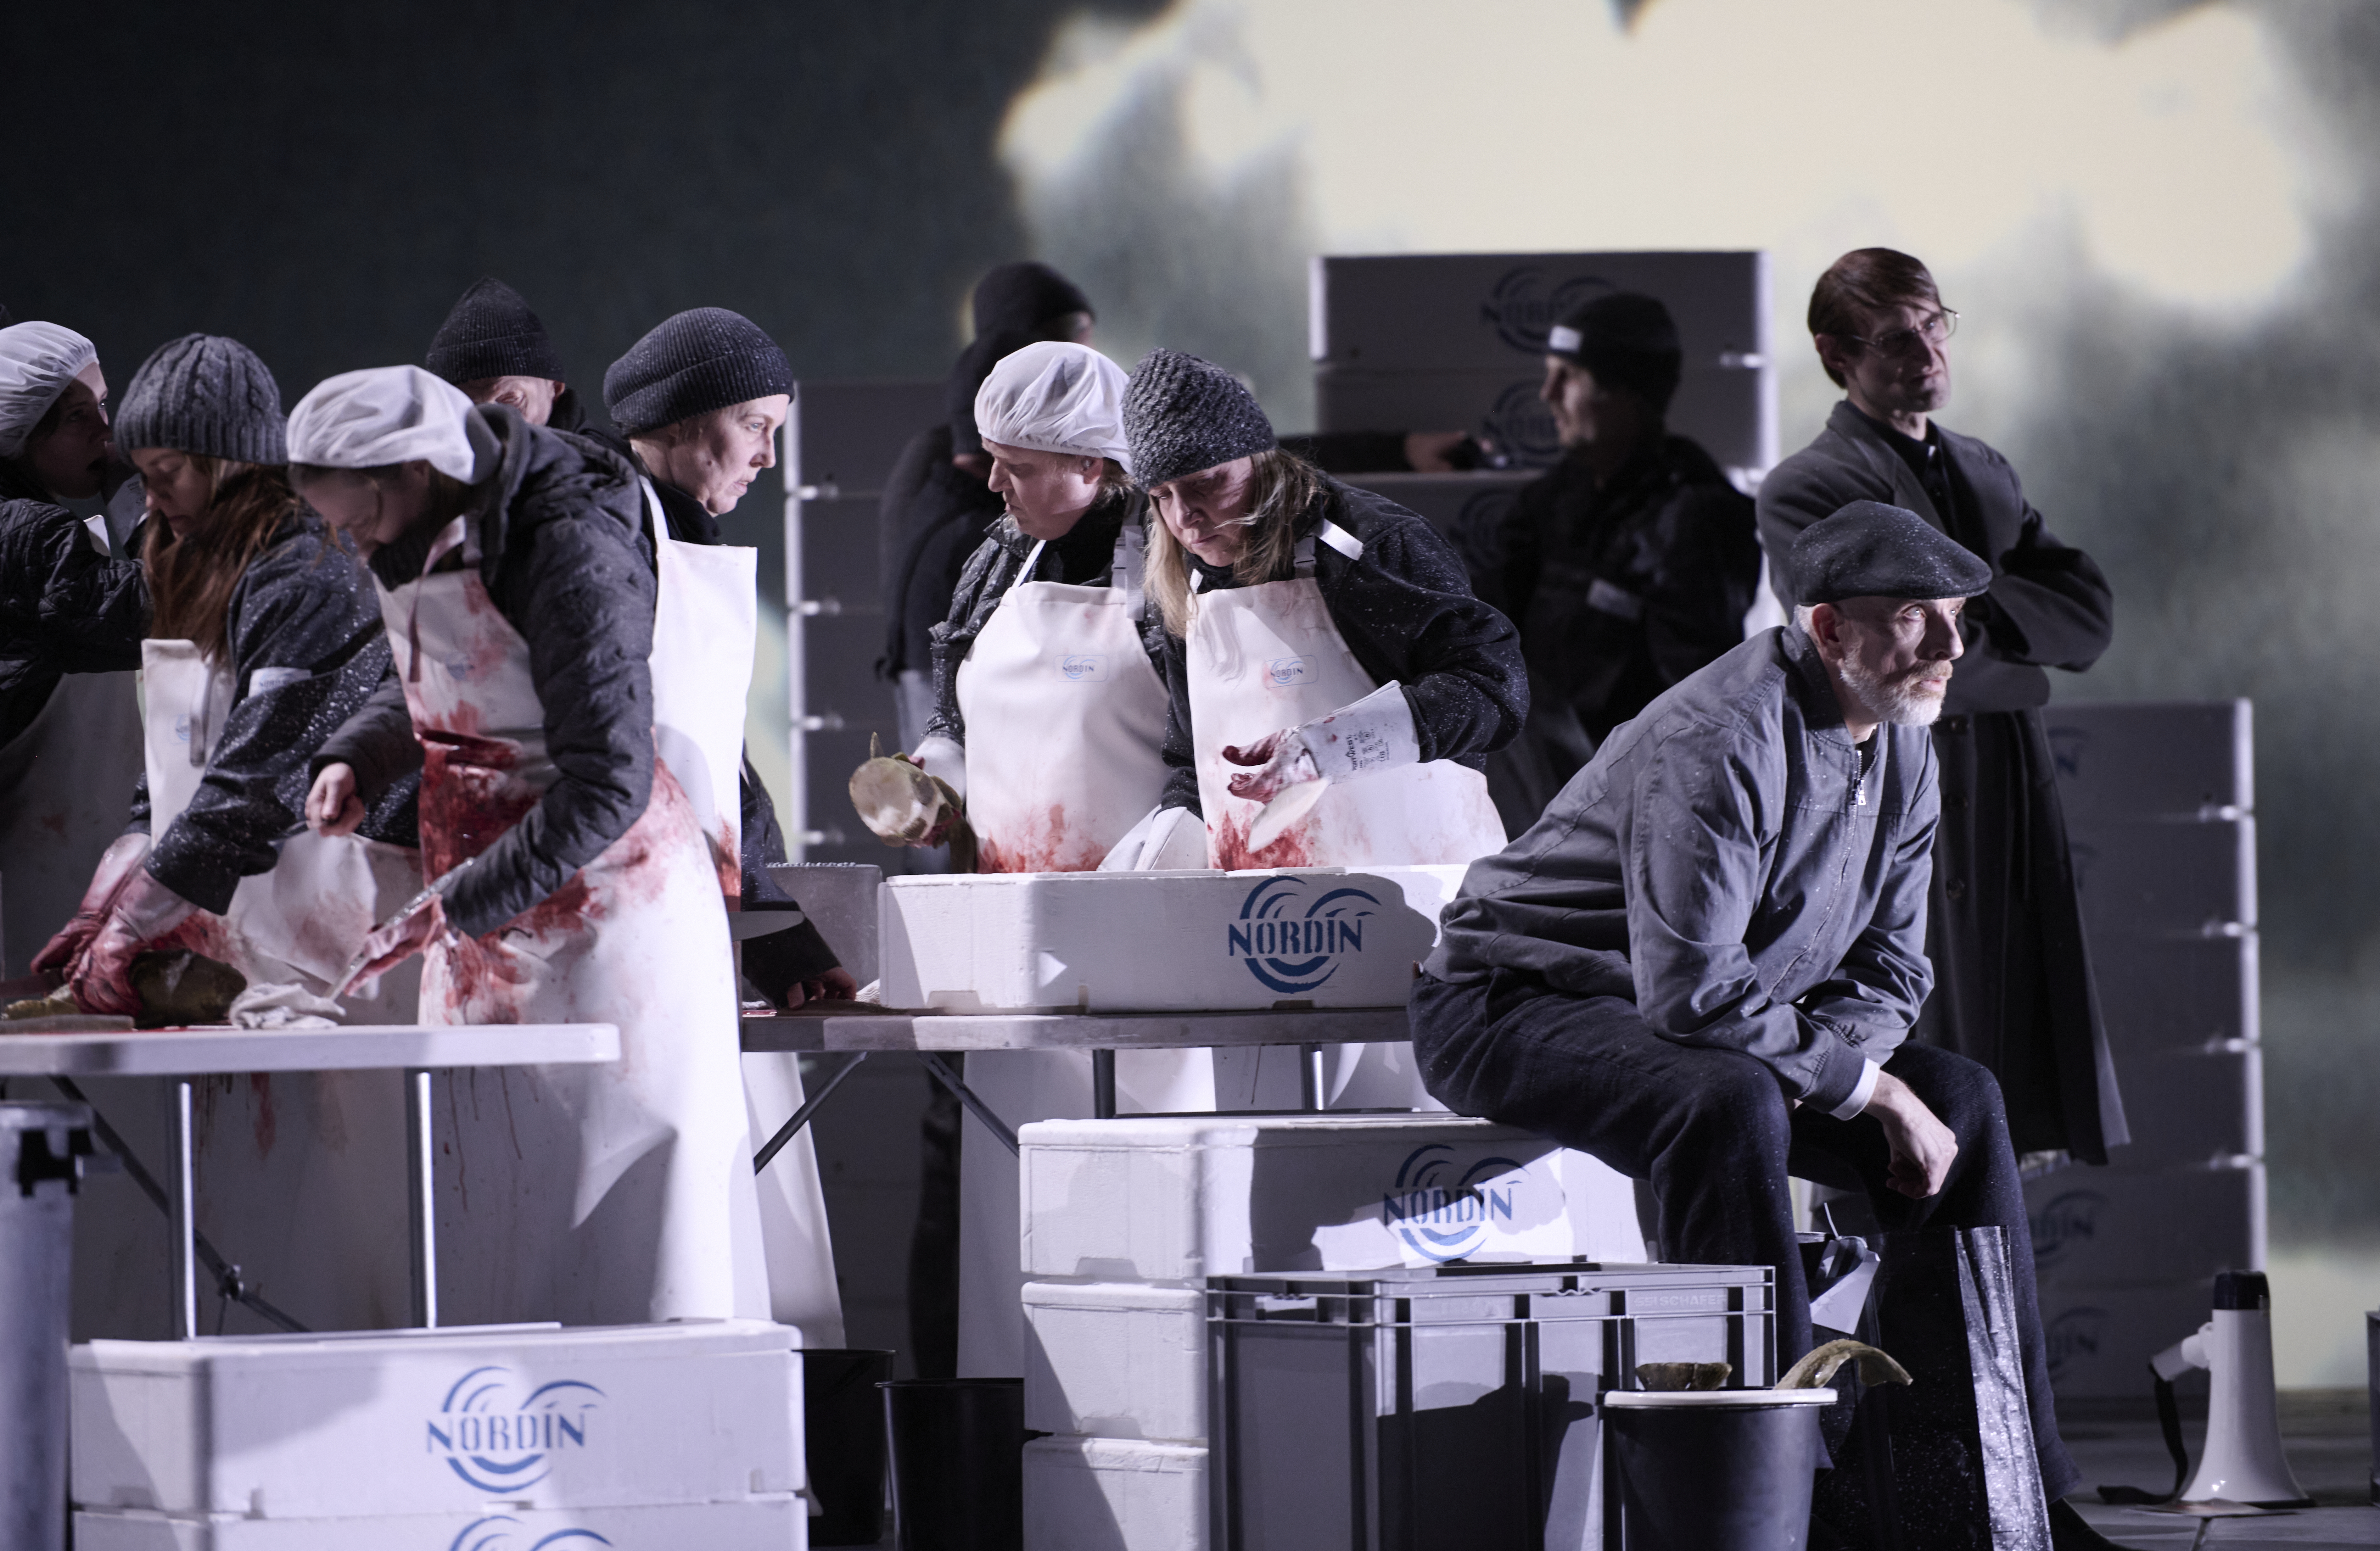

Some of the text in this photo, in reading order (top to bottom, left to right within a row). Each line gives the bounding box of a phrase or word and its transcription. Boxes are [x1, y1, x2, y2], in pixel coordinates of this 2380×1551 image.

[1270, 668, 1303, 677] NORDIN
[1228, 919, 1361, 956] NORDIN
[1384, 1187, 1512, 1225] NORDIN
[426, 1413, 586, 1453] NORDIN
